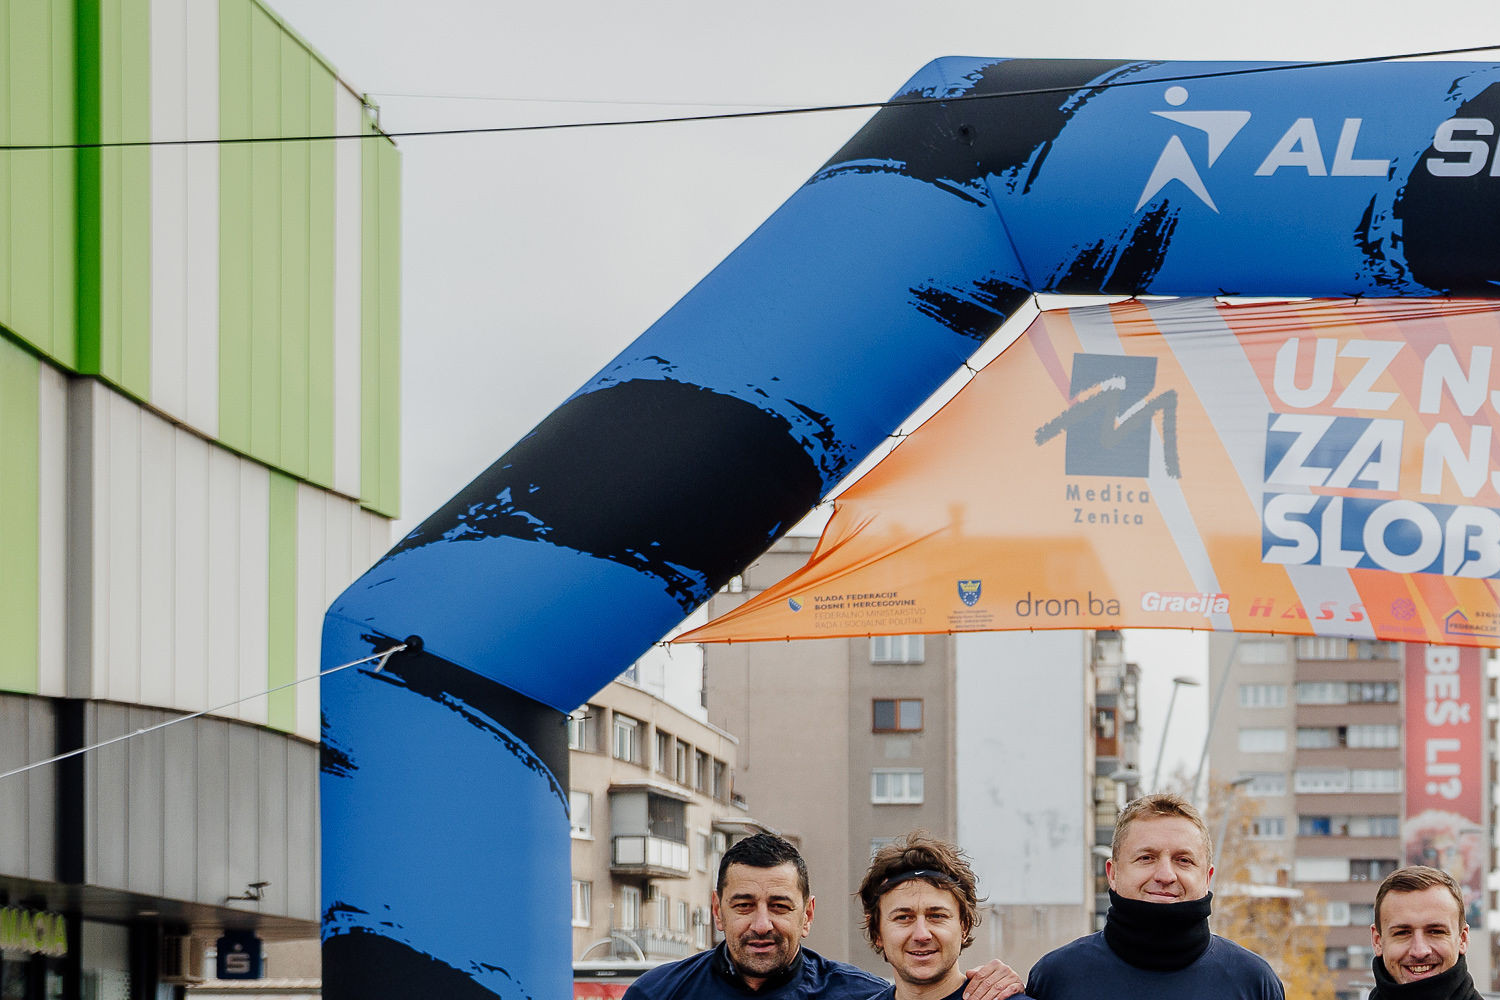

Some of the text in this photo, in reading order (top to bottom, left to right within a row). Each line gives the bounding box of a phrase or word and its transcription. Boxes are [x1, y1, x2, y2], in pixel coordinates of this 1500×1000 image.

[1253, 117, 1391, 178] AL
[1272, 337, 1406, 412] UZ
[1264, 413, 1403, 491] ZA
[1065, 482, 1150, 506] Medica
[1072, 506, 1146, 527] Zenica
[814, 602, 845, 611] BOSNE
[854, 599, 916, 609] HERCEGOVINE
[846, 592, 898, 601] FEDERACIJE
[1016, 590, 1121, 619] dron.ba
[1141, 591, 1230, 618] Gracija
[1425, 643, 1470, 800] BEŠ LI?
